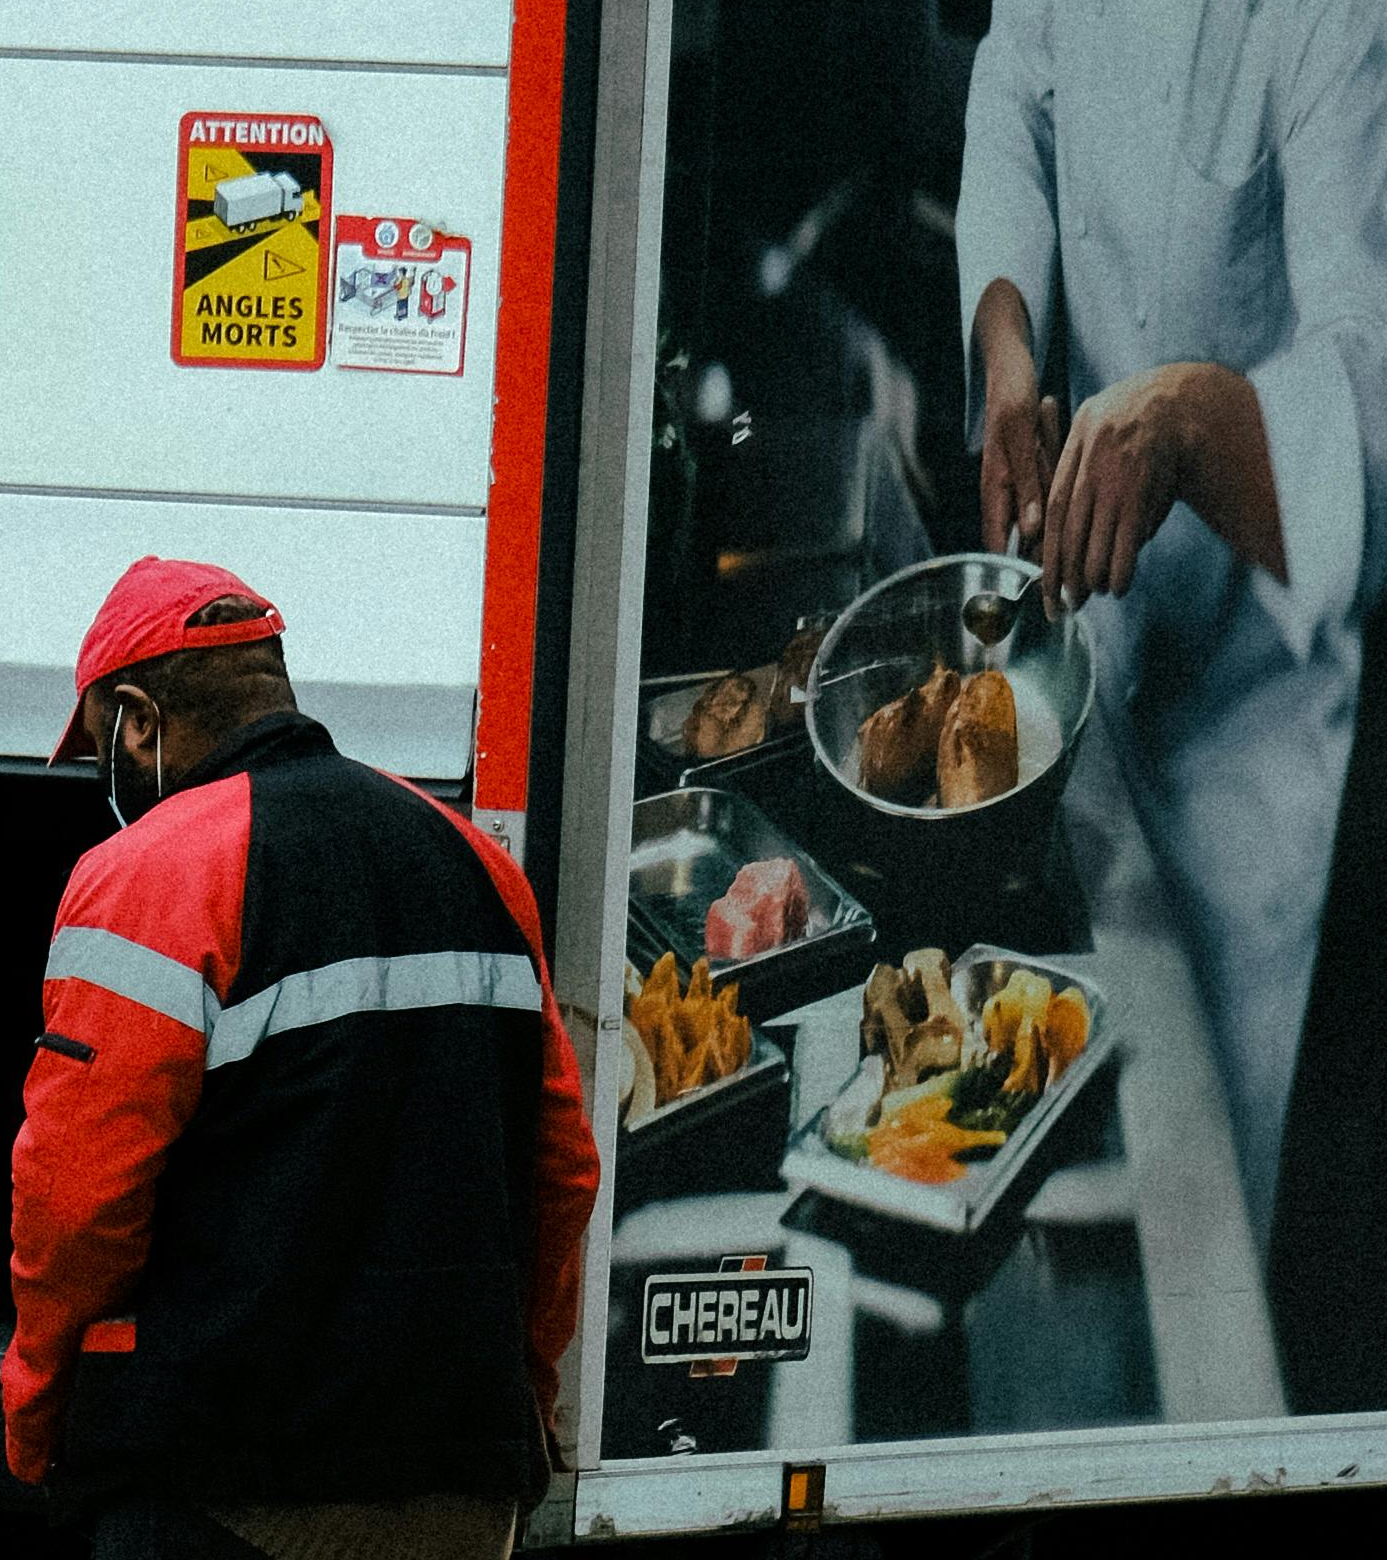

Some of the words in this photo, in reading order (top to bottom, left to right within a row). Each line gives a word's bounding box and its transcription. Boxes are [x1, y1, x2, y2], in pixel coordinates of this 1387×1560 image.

[189, 119, 324, 146] ATTENTION
[195, 294, 304, 320] ANGLES
[201, 322, 298, 348] MORTS
[649, 1287, 805, 1345] CHEREAU
